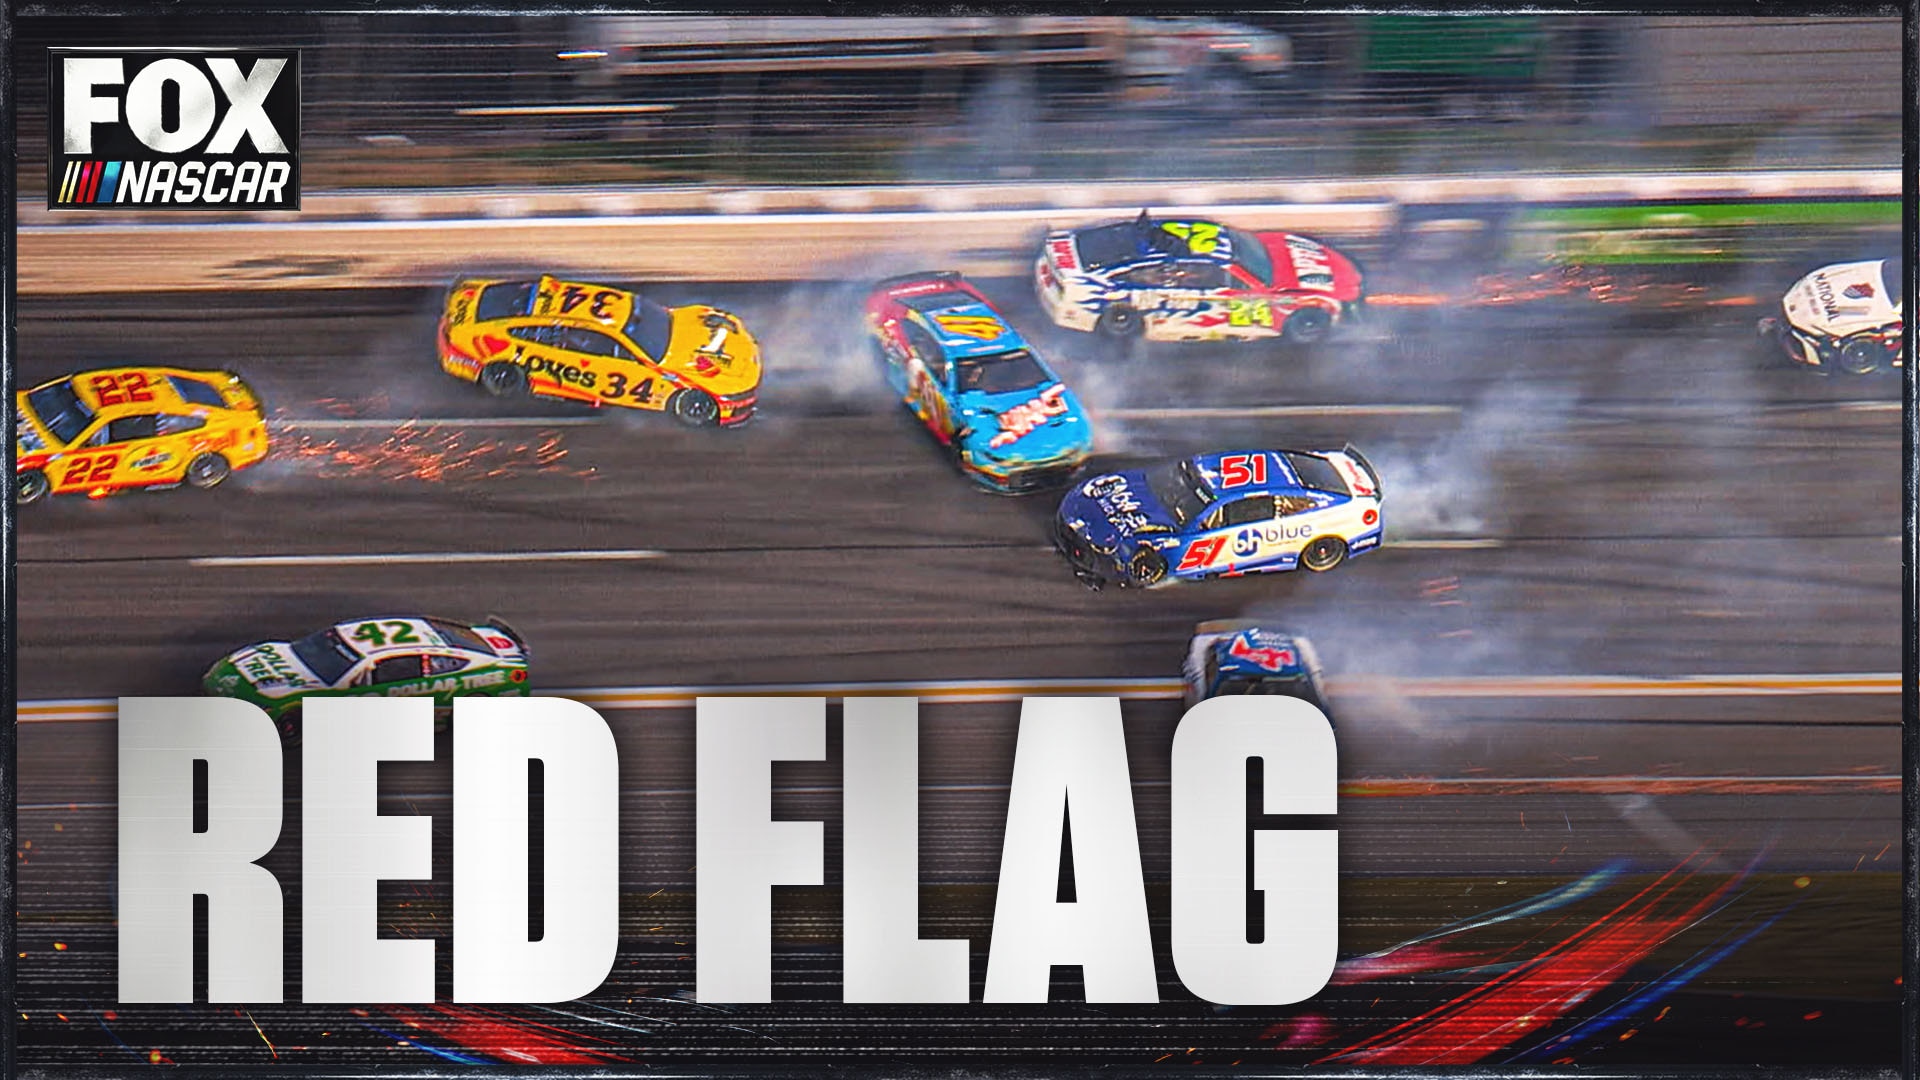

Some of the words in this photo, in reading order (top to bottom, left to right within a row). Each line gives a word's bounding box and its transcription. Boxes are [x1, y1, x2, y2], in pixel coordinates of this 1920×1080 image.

[559, 284, 625, 319] 34
[1228, 298, 1274, 327] 24
[1814, 272, 1841, 322] NATIONAL
[91, 371, 154, 408] 22
[599, 371, 656, 405] 34
[62, 452, 120, 487] 22
[1220, 453, 1268, 490] 51
[1265, 524, 1314, 543] blue
[1175, 535, 1230, 572] 51
[350, 620, 421, 648] 42
[254, 644, 308, 687] DOLLAR
[388, 677, 458, 697] DOLLAR
[460, 670, 506, 690] TREE
